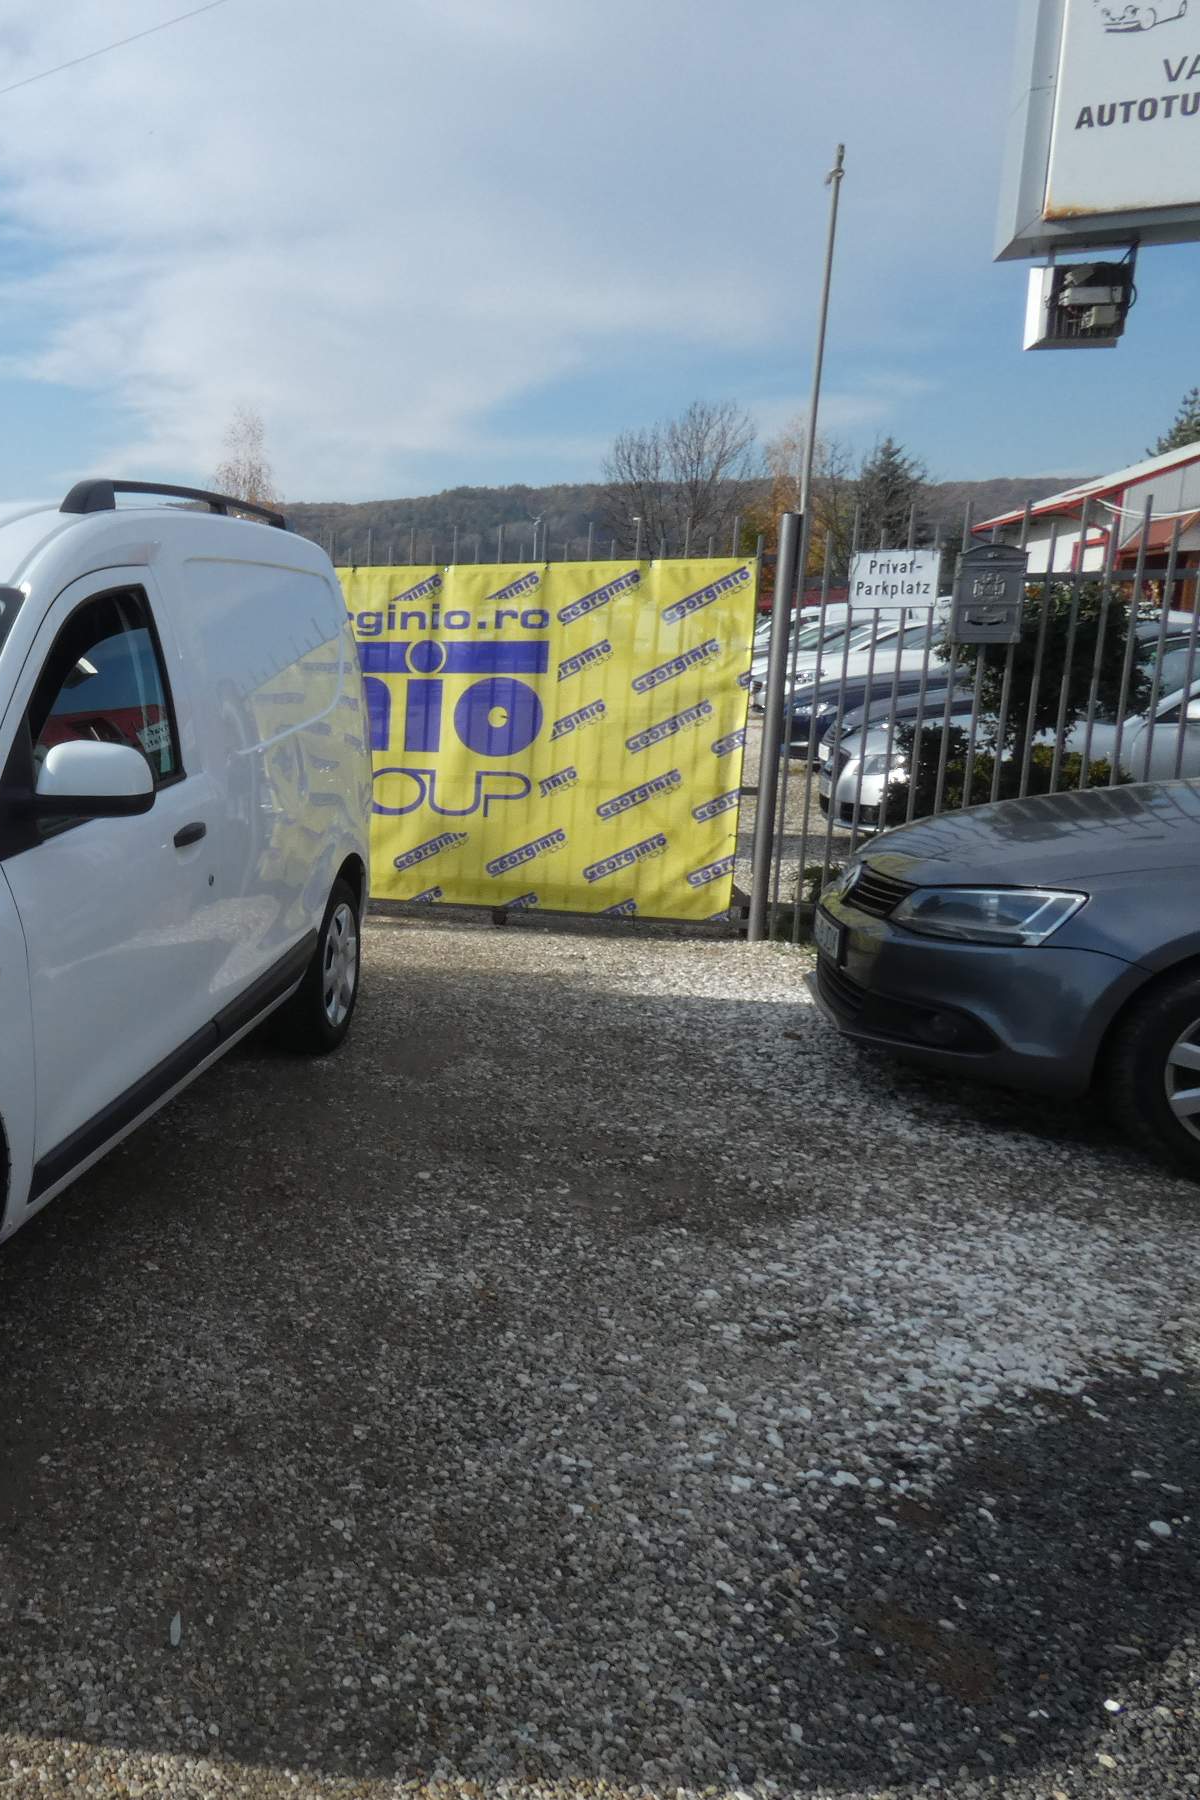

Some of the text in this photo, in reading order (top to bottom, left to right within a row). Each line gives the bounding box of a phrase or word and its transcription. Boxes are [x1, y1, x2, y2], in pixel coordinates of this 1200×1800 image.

[1075, 92, 1200, 130] AUTOTU
[856, 579, 931, 599] Parkplatz
[869, 559, 923, 575] Privat-
[348, 603, 549, 636] ginio.ro
[557, 569, 640, 626] Georginio
[661, 566, 750, 625] Georginio
[558, 638, 611, 682] rginio
[632, 638, 720, 695] Georginio
[625, 698, 712, 755] Georginio
[596, 768, 681, 821] Georginio
[486, 828, 566, 878] Georginio
[583, 833, 667, 884] Georginio
